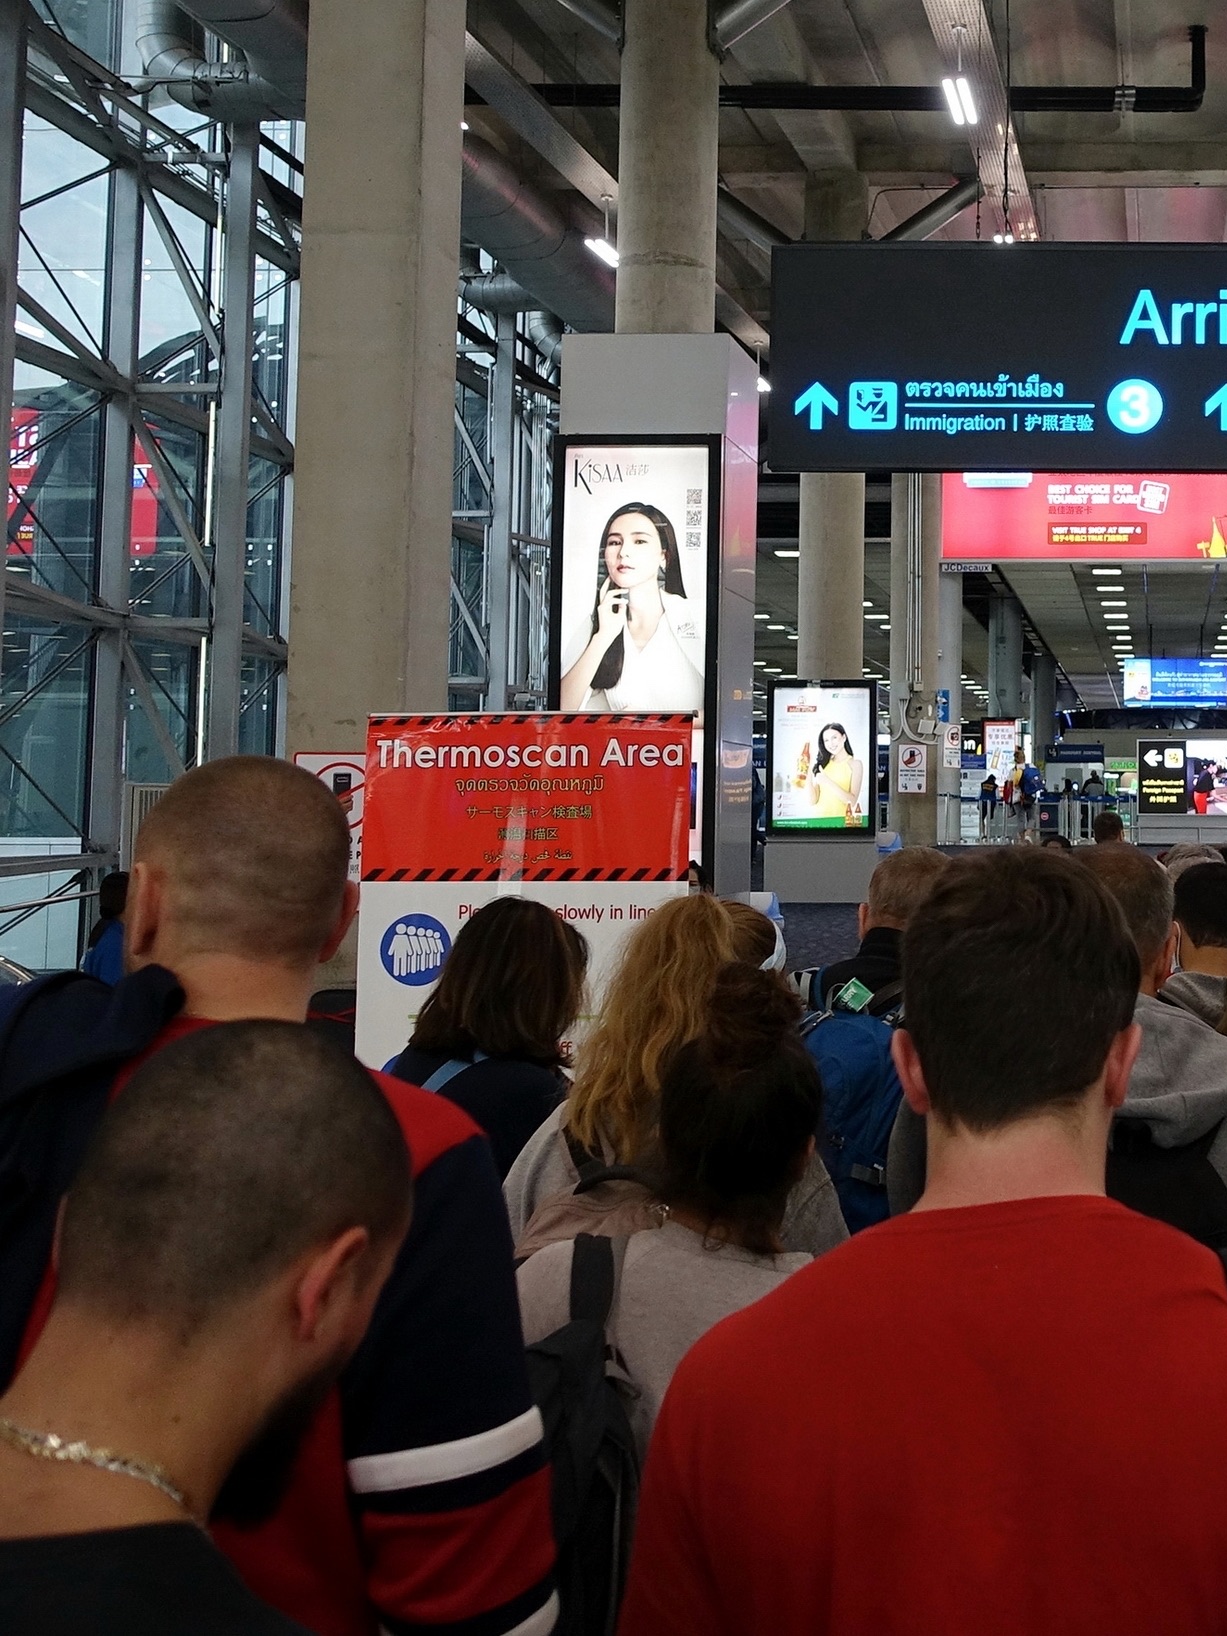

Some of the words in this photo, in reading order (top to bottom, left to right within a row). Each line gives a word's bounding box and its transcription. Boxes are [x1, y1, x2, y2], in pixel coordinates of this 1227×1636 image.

[904, 373, 1065, 399] ตรวจคนเข้าเมือง
[1119, 384, 1149, 427] 3
[904, 413, 1006, 434] Immigration
[1024, 414, 1095, 432] 护照查验
[1047, 484, 1072, 494] BEST
[1074, 484, 1111, 494] CHOICE
[1113, 484, 1134, 494] FOR
[1046, 494, 1089, 504] TOURIST
[1048, 505, 1093, 515] 最佳游客卡
[944, 563, 990, 571] JCDecaux
[376, 738, 589, 769] Thermoscan
[599, 737, 685, 768] Area
[455, 773, 604, 796] จุดตรวจวัดอุณหภูมิ
[466, 805, 593, 819] サーモスキャン検査場
[554, 903, 605, 924] slowly
[609, 904, 623, 920] in
